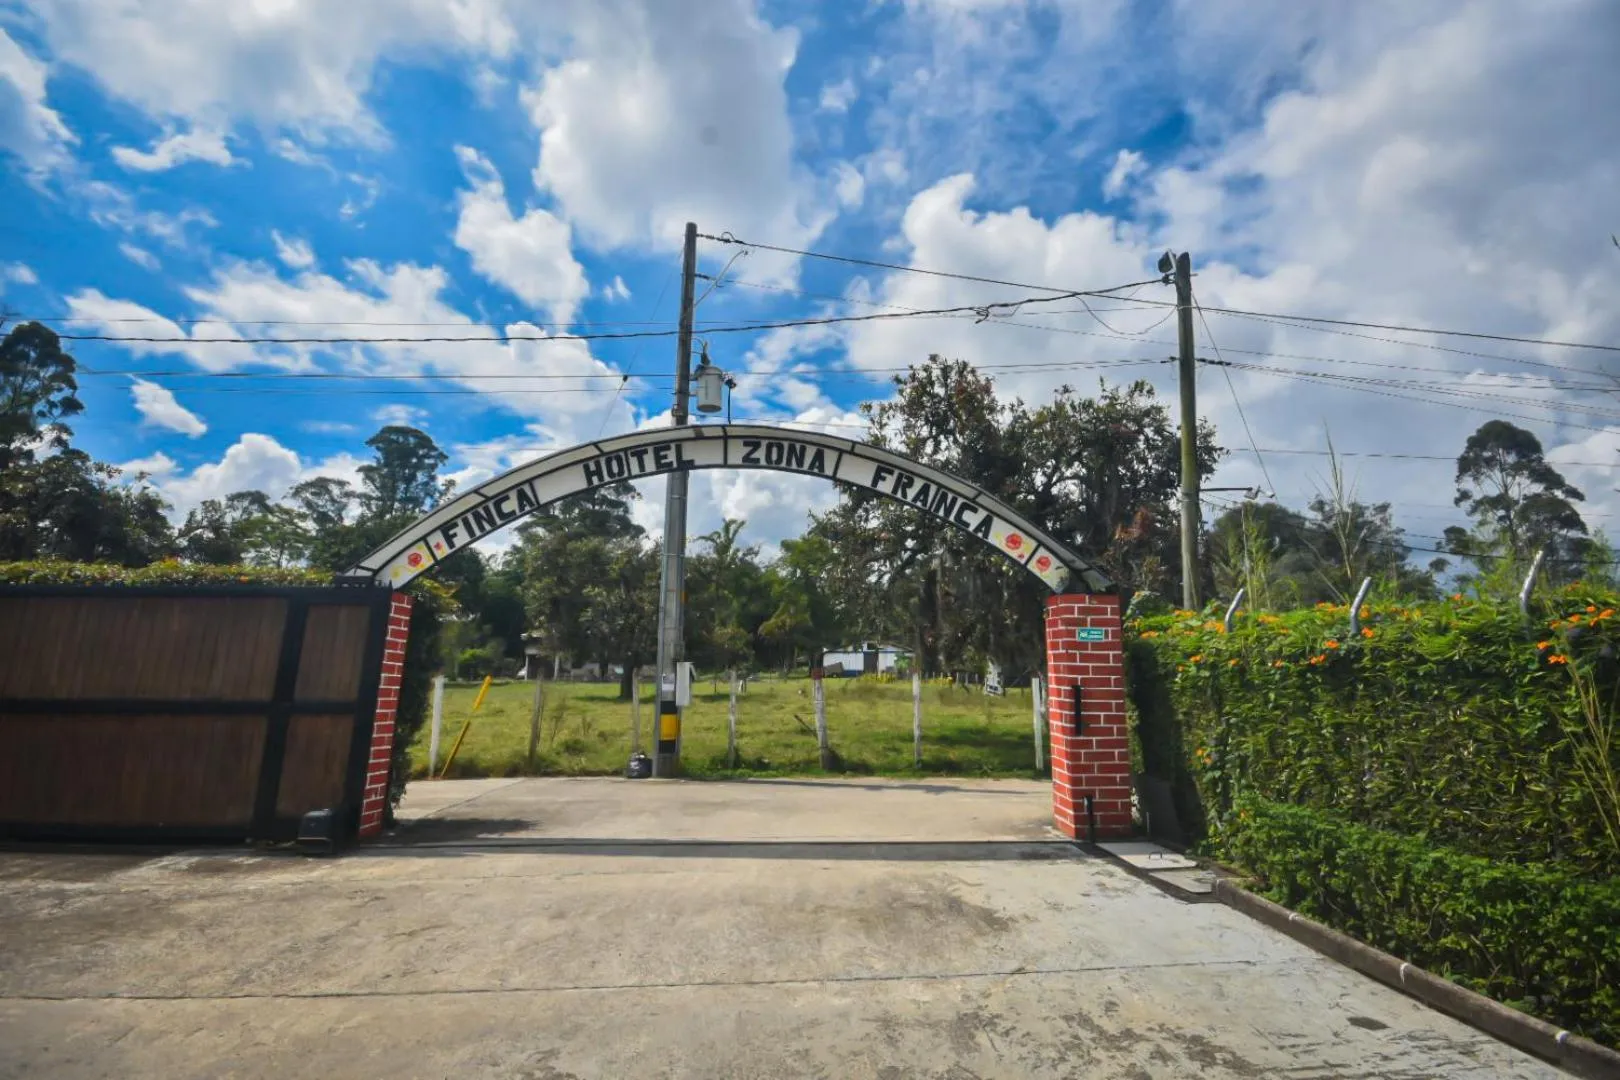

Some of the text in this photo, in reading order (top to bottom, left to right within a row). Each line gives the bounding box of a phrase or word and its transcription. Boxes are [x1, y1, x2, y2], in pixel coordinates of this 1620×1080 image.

[439, 440, 994, 550] FINCA HOTEL ZONA FRANCA
